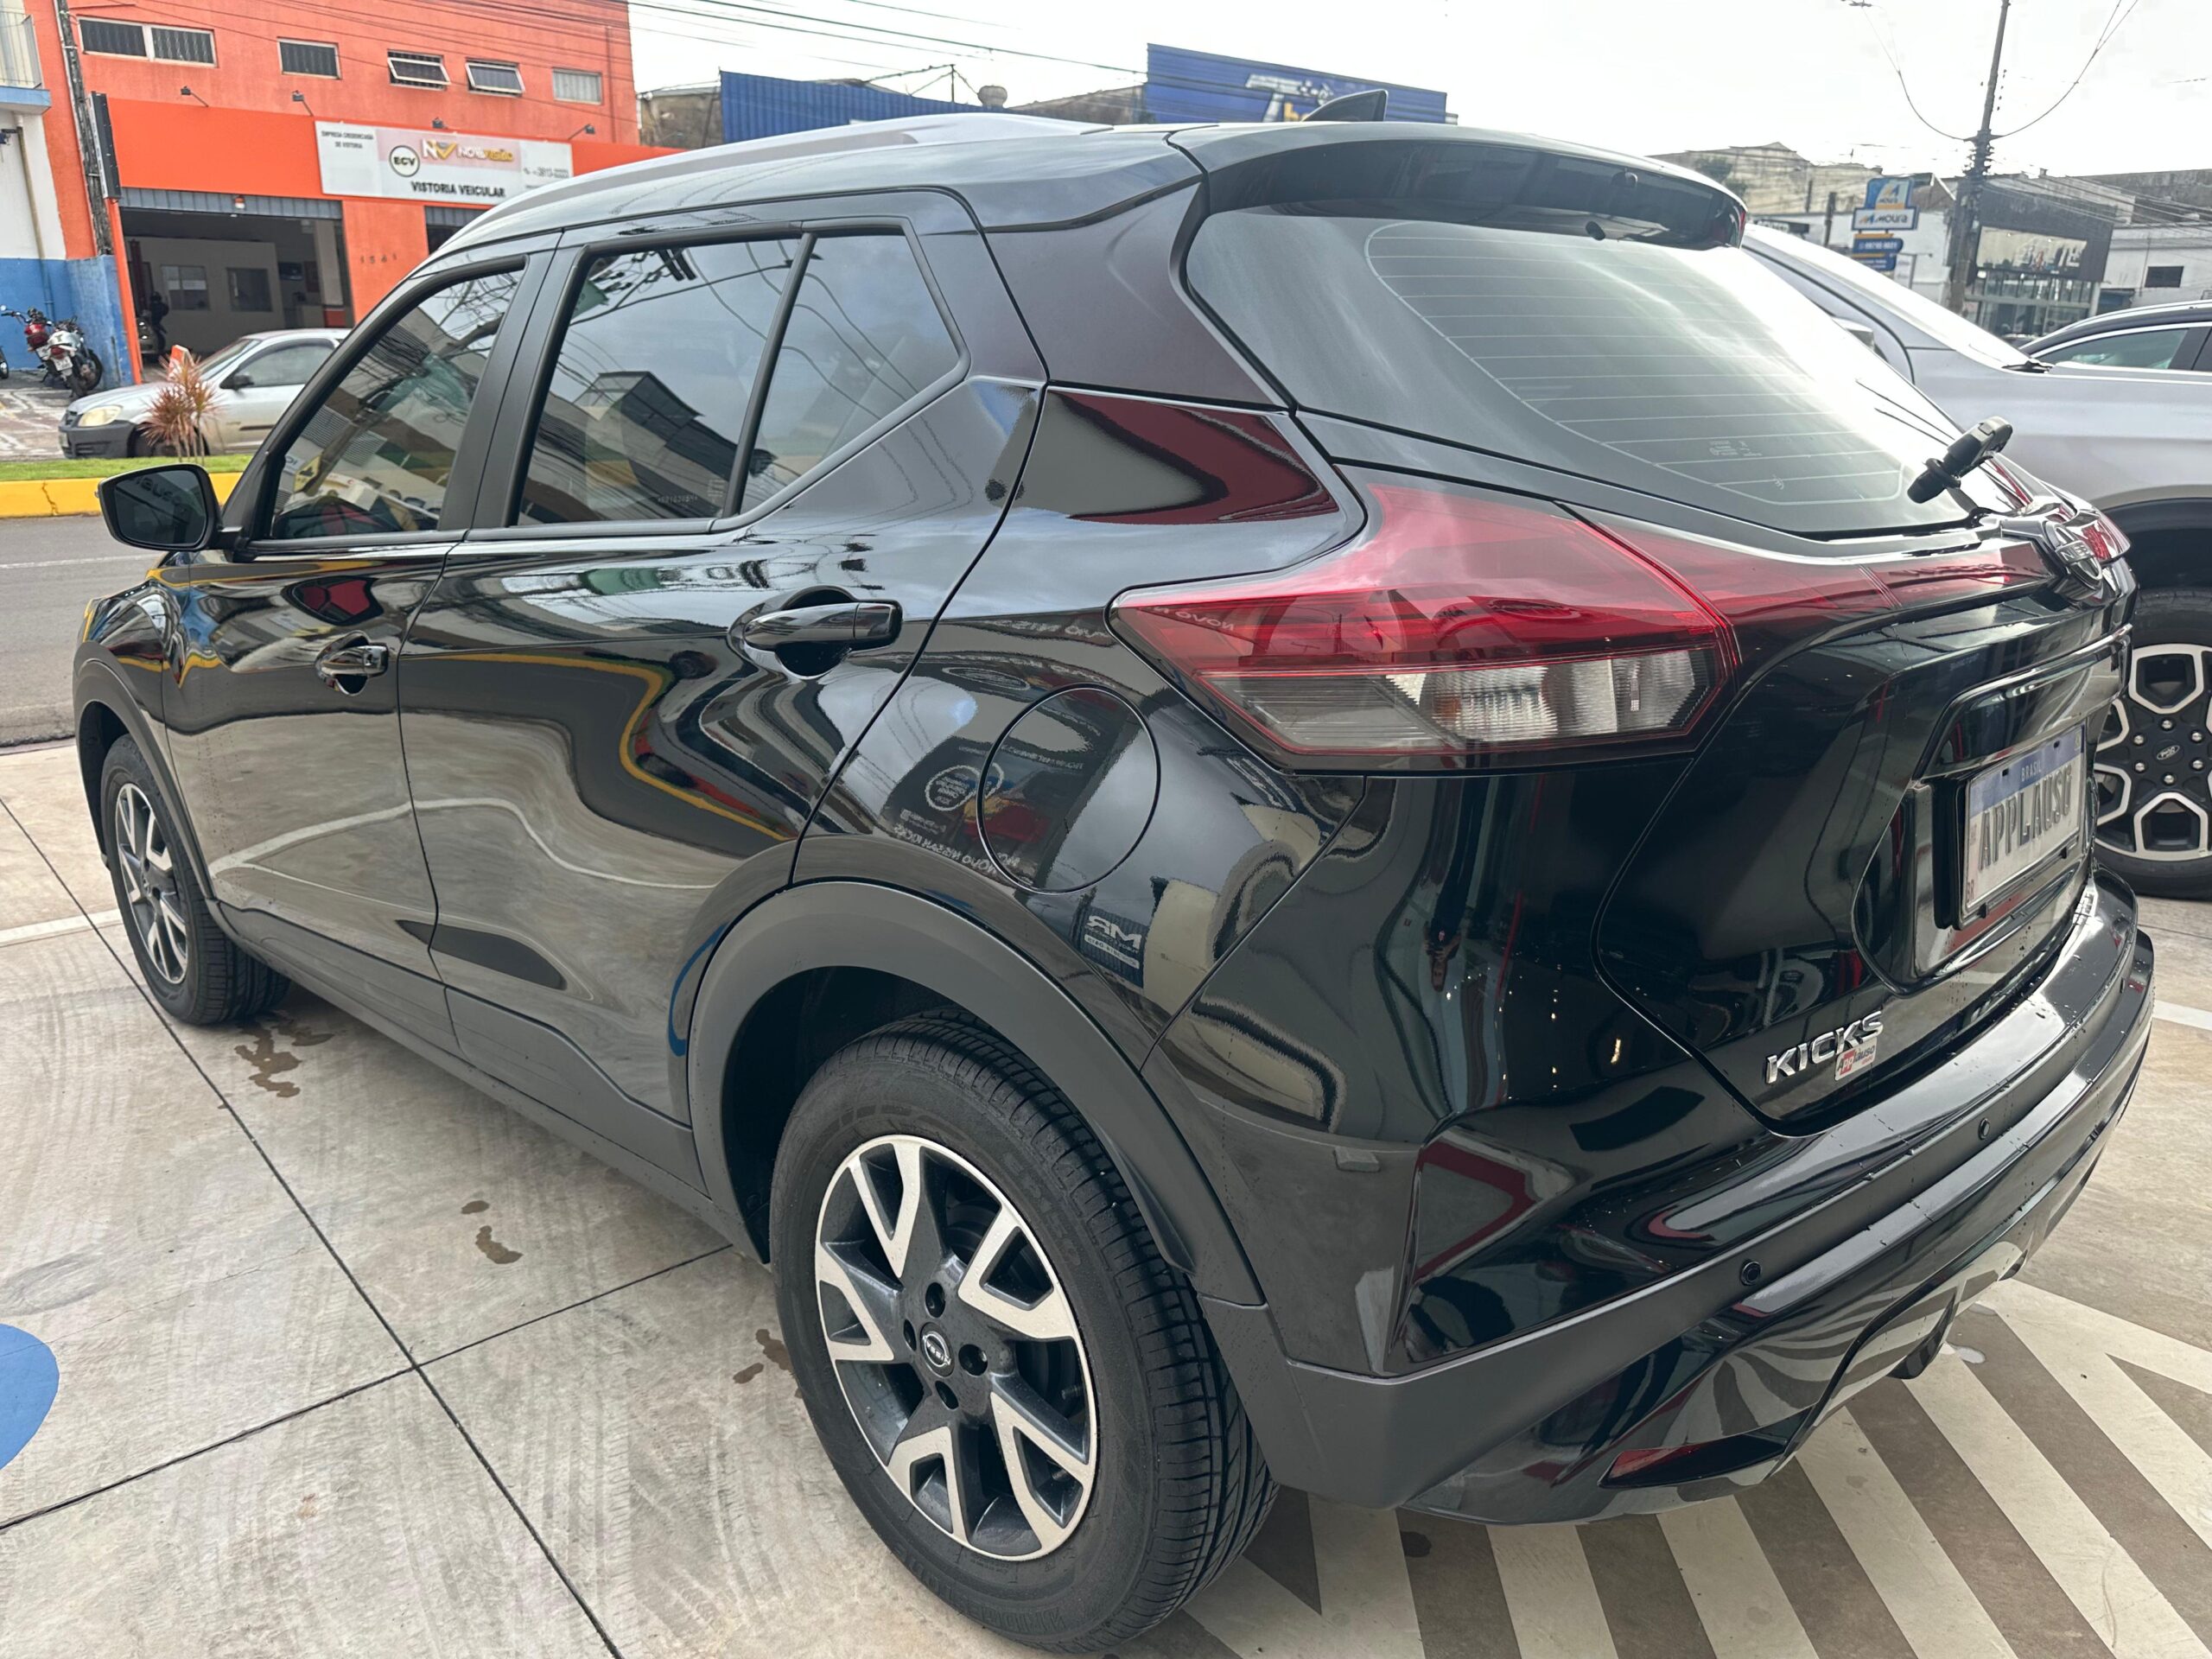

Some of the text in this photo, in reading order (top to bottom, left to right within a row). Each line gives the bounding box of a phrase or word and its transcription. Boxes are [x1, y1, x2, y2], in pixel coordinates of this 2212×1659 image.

[393, 156, 416, 166] ECV
[410, 181, 506, 198] VISTORIA VEICULAR
[1979, 764, 2072, 871] APPLAUSO
[1766, 1011, 1885, 1085] KICKS
